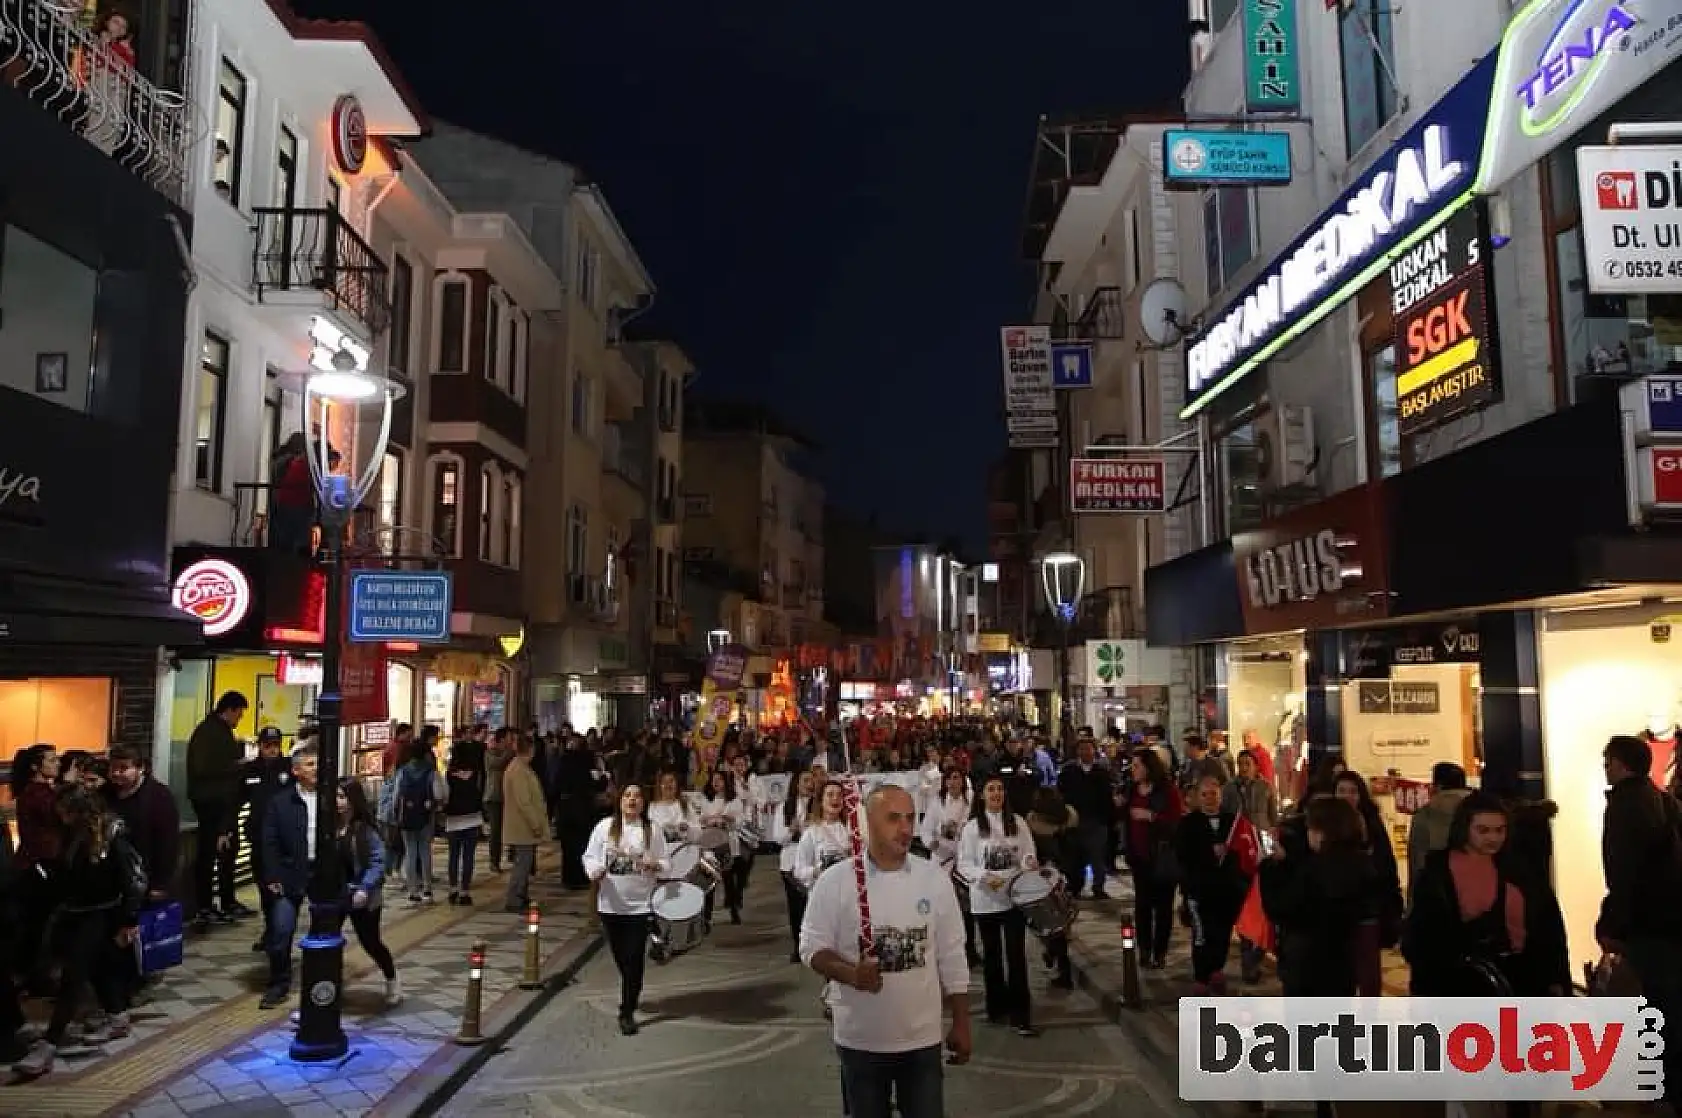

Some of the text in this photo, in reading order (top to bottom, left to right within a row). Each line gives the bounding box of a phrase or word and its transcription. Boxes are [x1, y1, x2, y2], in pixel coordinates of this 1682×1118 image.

[1515, 6, 1638, 109] TENA
[1612, 223, 1647, 248] Dt.
[1625, 260, 1663, 278] 0532
[1407, 289, 1472, 366] SGK
[1080, 463, 1156, 478] FURKAN
